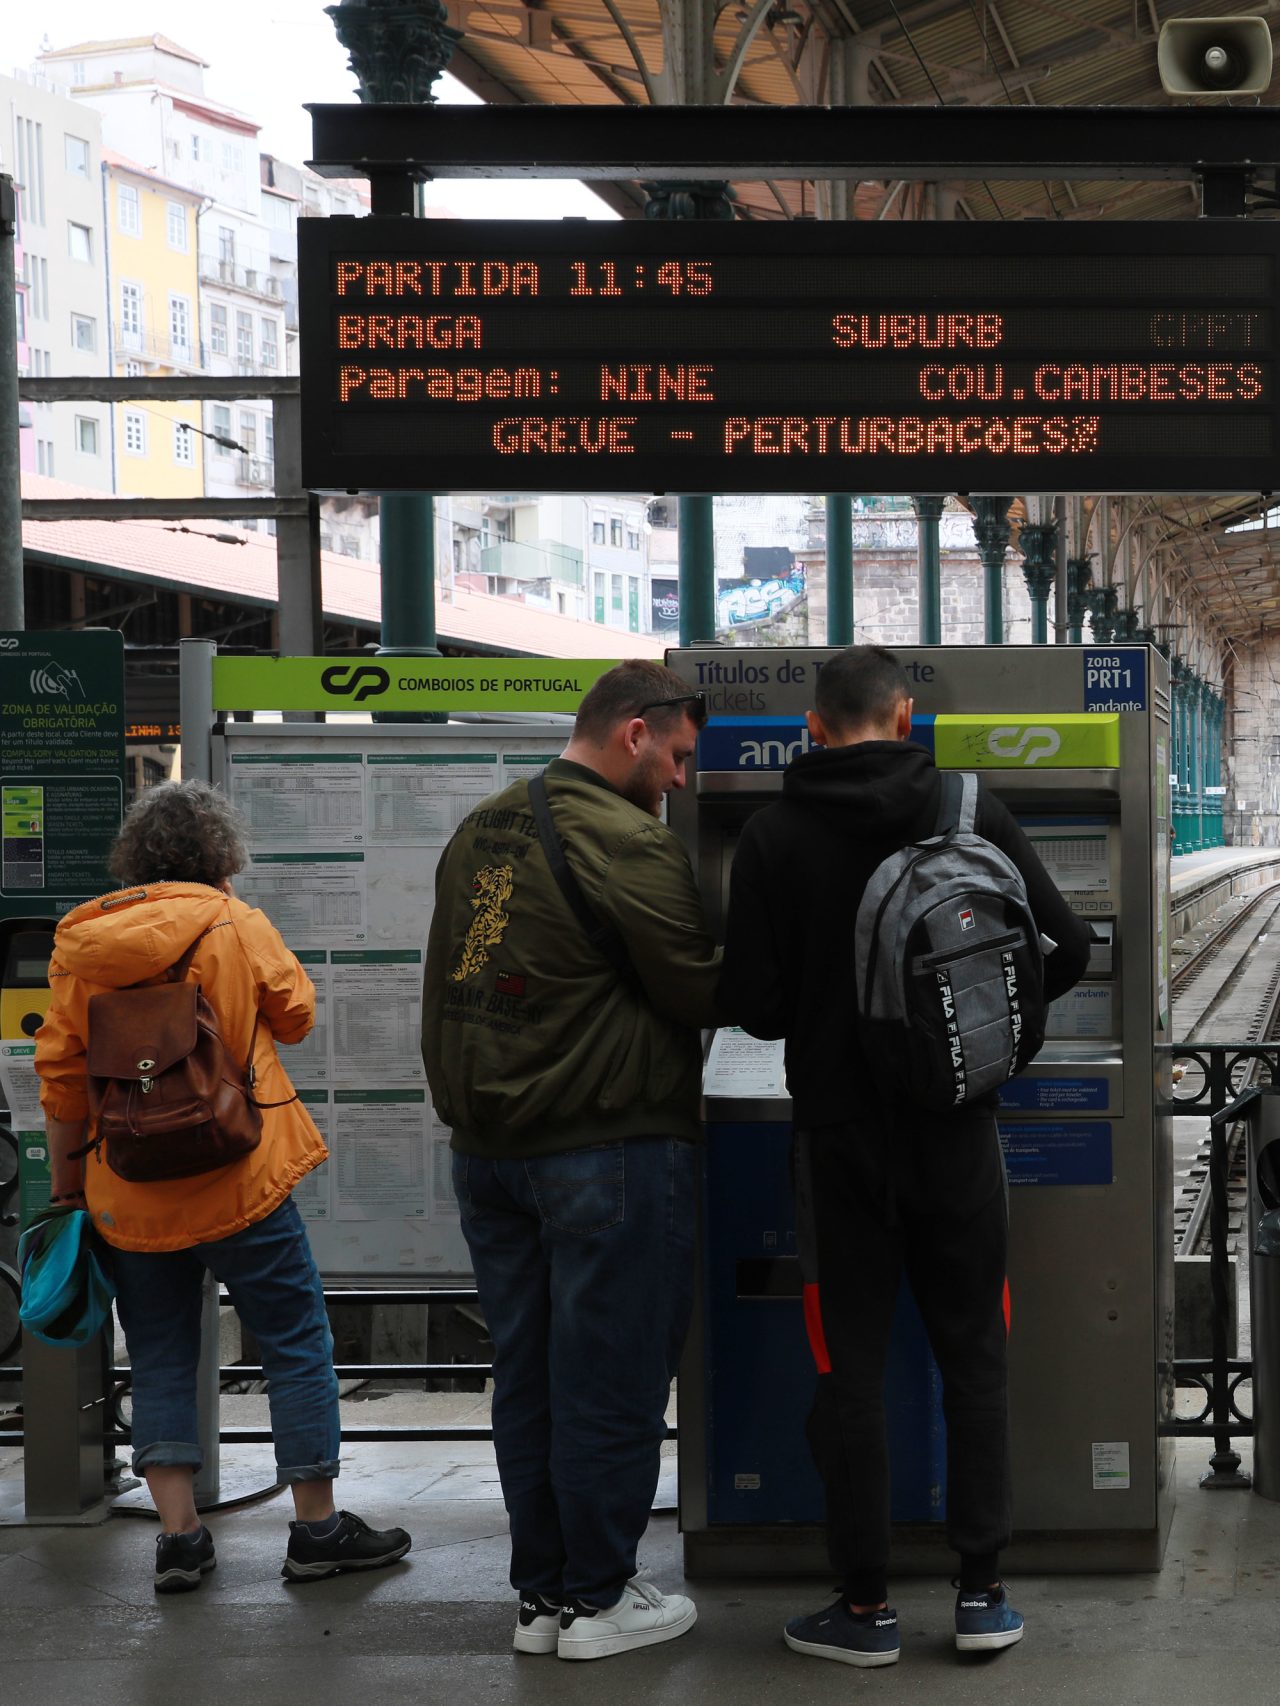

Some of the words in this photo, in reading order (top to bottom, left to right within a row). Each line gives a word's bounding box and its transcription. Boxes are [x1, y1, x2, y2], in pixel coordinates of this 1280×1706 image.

[338, 262, 538, 295] PARTIDA
[571, 262, 712, 295] 11:45
[340, 316, 481, 348] BRAGA
[833, 315, 1002, 347] SUBURB
[341, 366, 558, 401] Paragem:
[602, 365, 713, 400] NINE
[493, 417, 638, 453] GREVE
[672, 432, 693, 440] -
[1087, 656, 1120, 668] zona
[695, 659, 769, 684] Títulos
[777, 659, 805, 684] de
[398, 678, 475, 692] COMBOIOS
[480, 678, 499, 692] DE
[504, 678, 583, 692] PORTUGAL
[1087, 669, 1132, 689] PRT1
[2, 704, 32, 715] ZONA
[36, 704, 50, 715] DE
[54, 702, 117, 717] VALIDAÇÃO
[1088, 699, 1142, 711] andante
[23, 717, 96, 728] OBRIGATÓRIA
[125, 725, 161, 737] LINHA
[477, 810, 517, 831] FLIGHT
[1003, 965, 1018, 997] FILA
[1074, 988, 1110, 999] andante
[940, 986, 955, 1018] FILA
[949, 1035, 963, 1067] FILA
[522, 1602, 536, 1611] FILA
[562, 1606, 575, 1614] FILA
[961, 1600, 988, 1608] Reebok
[876, 1617, 897, 1627] Reebo
